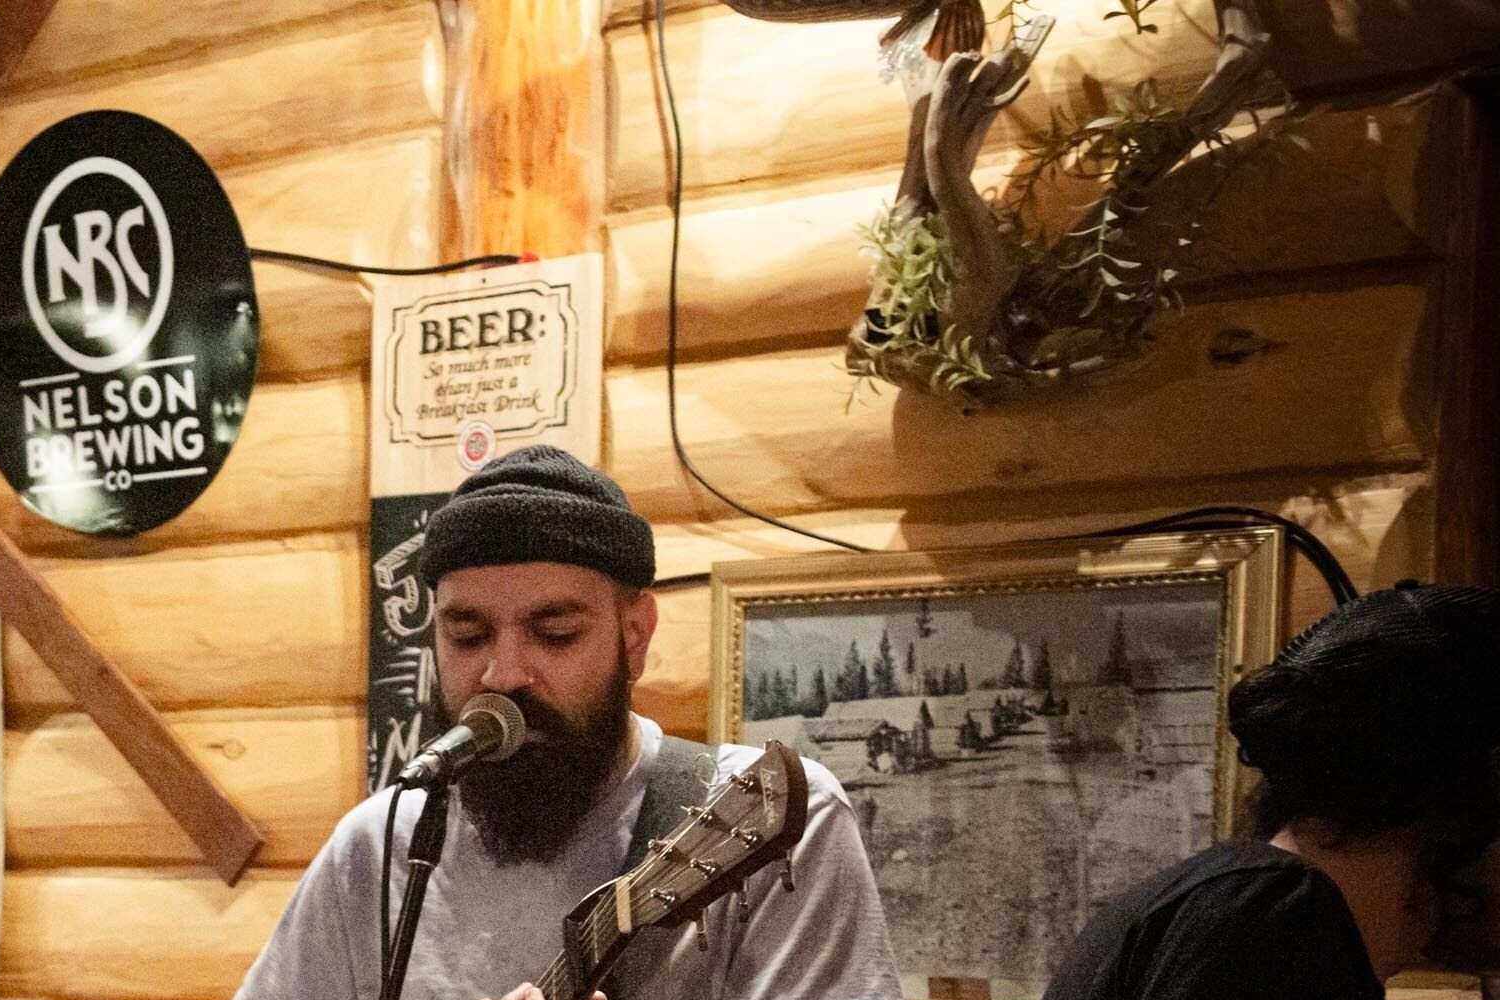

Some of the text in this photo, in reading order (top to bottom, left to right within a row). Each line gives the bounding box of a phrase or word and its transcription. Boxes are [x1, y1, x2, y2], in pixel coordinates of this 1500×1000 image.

[419, 307, 547, 355] BEER:
[423, 352, 531, 379] So much more
[22, 369, 197, 432] NELSON
[417, 388, 546, 423] Breakfast Drink
[472, 376, 504, 401] just
[509, 376, 518, 389] a
[26, 415, 204, 479] BREWING
[102, 468, 134, 491] CO
